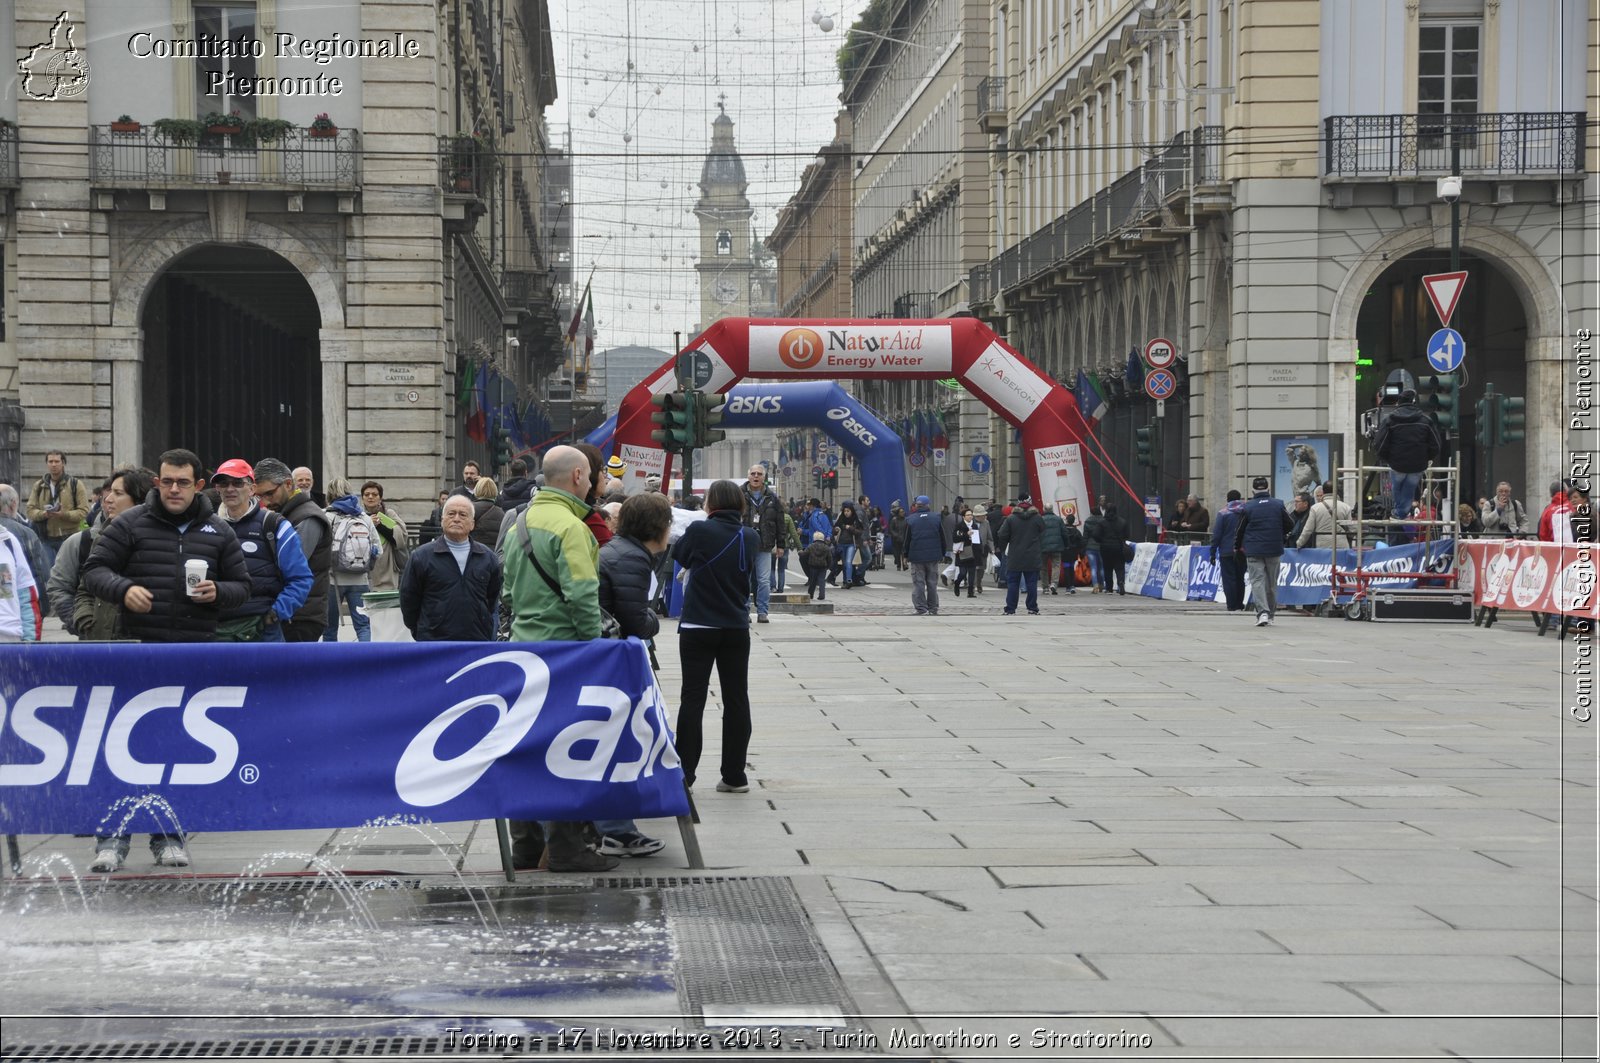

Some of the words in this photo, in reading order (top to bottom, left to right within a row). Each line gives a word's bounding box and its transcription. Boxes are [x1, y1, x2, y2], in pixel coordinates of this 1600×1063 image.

[828, 329, 922, 352] NaturAid
[828, 355, 876, 368] Energy
[881, 355, 923, 366] Water
[993, 369, 1036, 406] ABEKOM
[729, 396, 782, 413] asics
[842, 417, 877, 446] asics
[624, 447, 664, 461] NaturAid
[1039, 445, 1077, 461] NaturAid
[623, 458, 643, 467] Energy
[1040, 460, 1060, 468] Energy
